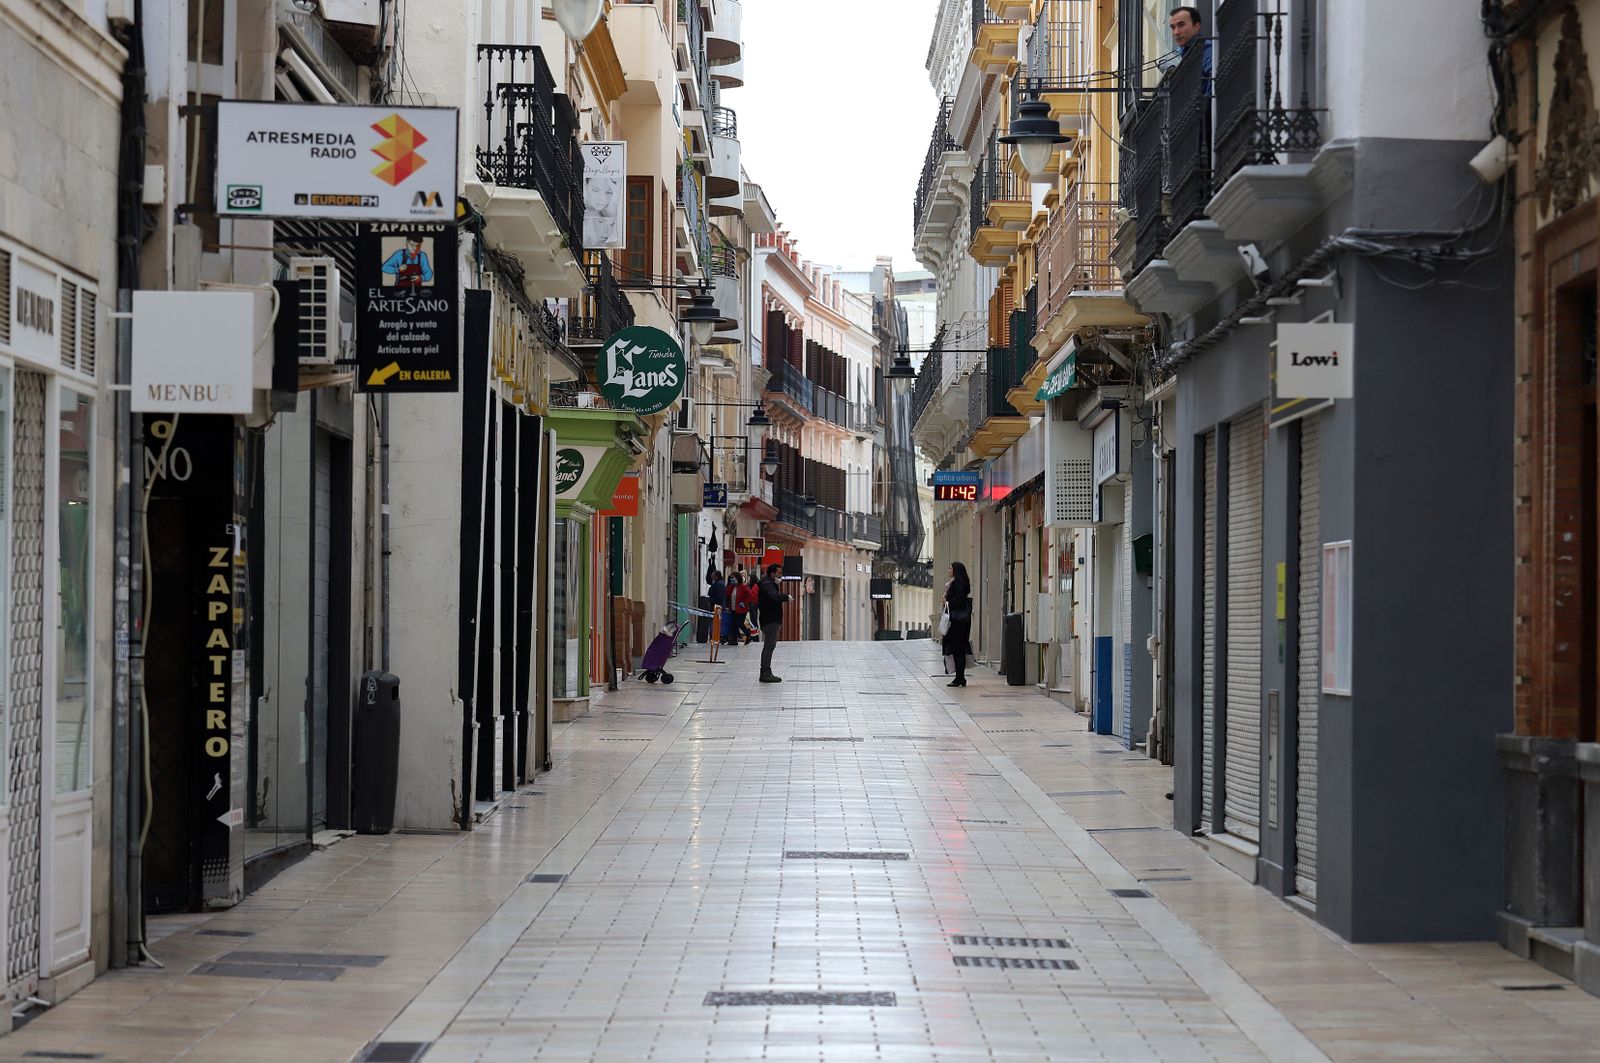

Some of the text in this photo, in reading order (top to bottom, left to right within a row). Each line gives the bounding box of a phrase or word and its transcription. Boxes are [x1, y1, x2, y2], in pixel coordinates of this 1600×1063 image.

[246, 131, 356, 146] ATRESMEDIA
[310, 147, 357, 160] RADIO
[370, 223, 446, 233] ZAPATERO
[369, 288, 385, 298] EL
[379, 319, 437, 330] Arreglo y venta
[386, 332, 430, 341] del calzado
[377, 344, 439, 355] Artículos en piel
[648, 350, 676, 360] Tiendas
[1291, 351, 1339, 366] Lowi
[399, 369, 451, 381] EN GALERIA
[148, 384, 233, 402] MENBU
[941, 486, 976, 500] 11:42
[205, 547, 230, 757] ZAPATERO
